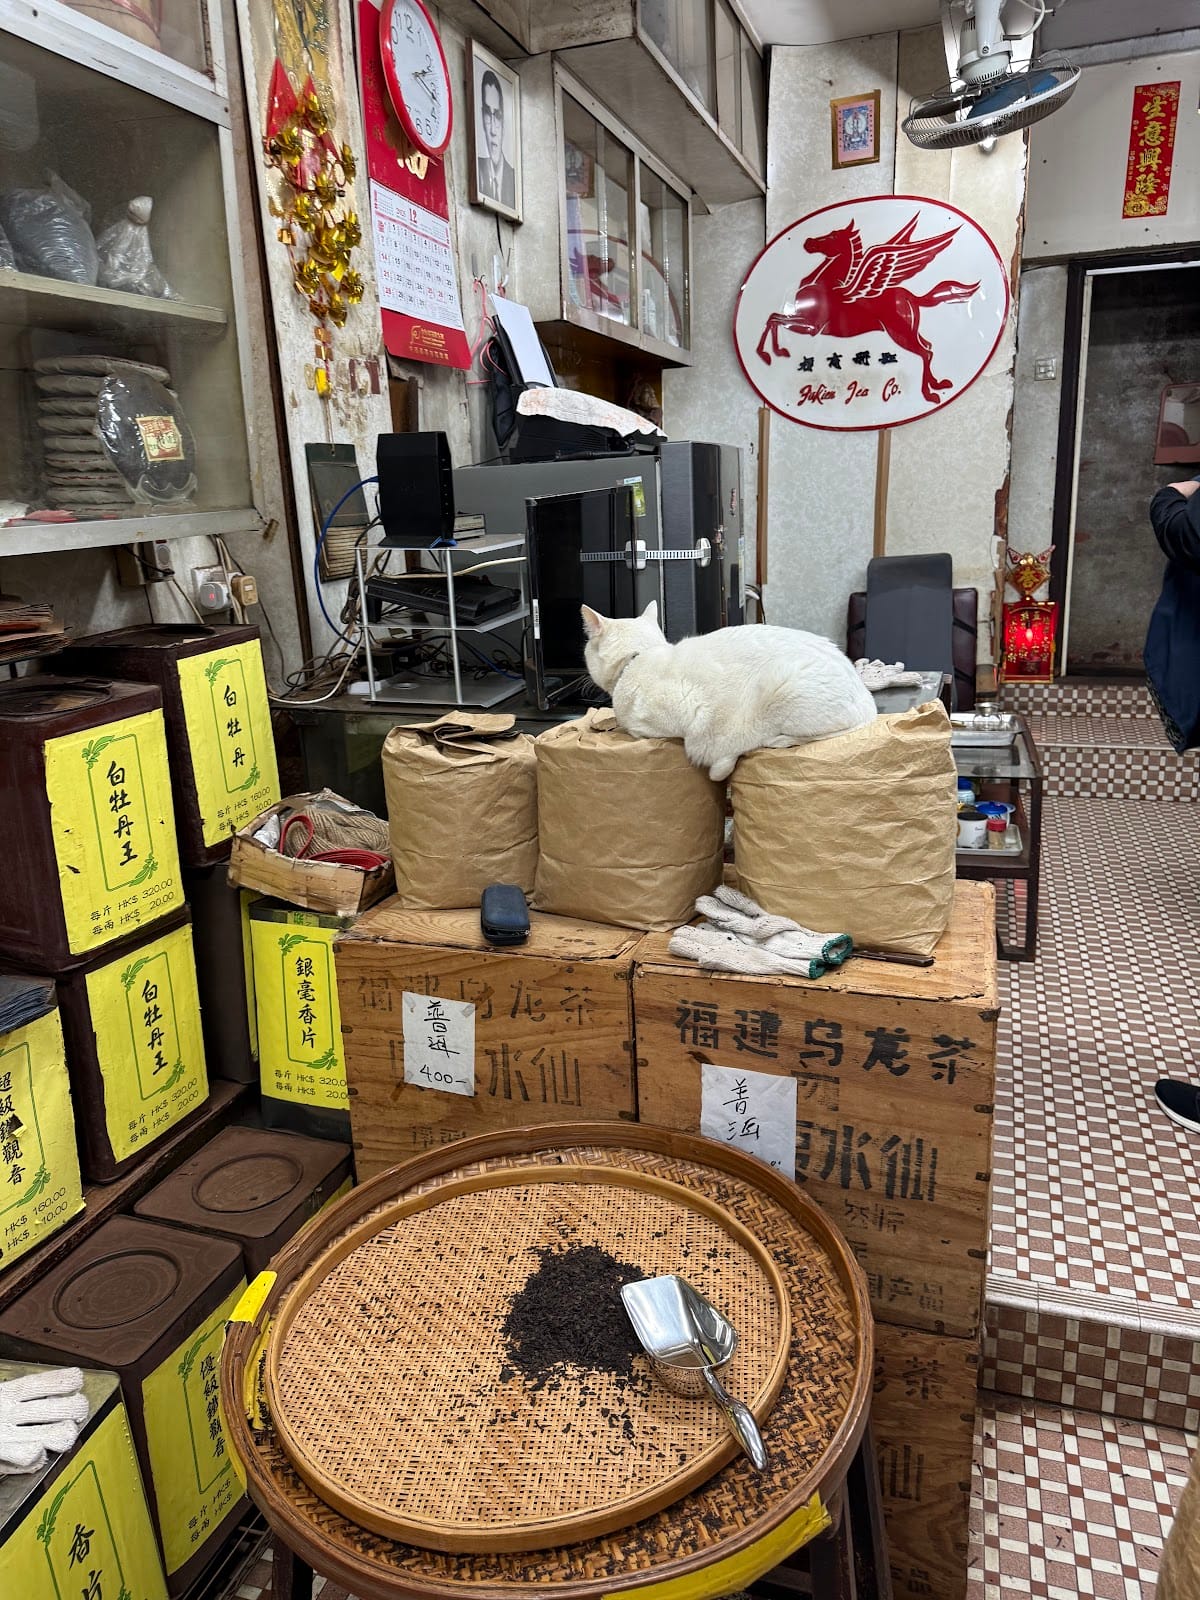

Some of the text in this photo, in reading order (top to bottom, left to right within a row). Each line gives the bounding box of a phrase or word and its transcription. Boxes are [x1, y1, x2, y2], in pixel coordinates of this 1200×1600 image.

[1135, 95, 1167, 195] 生意興隆
[409, 207, 417, 224] 12
[797, 384, 836, 406] Fukien
[882, 377, 902, 403] Co.
[223, 684, 246, 768] 白牡丹
[107, 761, 138, 866] 白牡丹王
[234, 800, 248, 811] HK$
[251, 786, 271, 801] 160.00
[236, 811, 250, 822] HK$
[256, 798, 272, 812] 10.00
[118, 895, 139, 911] HK$
[142, 878, 173, 899] 320.00
[120, 909, 141, 925] HK$
[149, 891, 175, 911] 20.00
[295, 956, 317, 1049] 銀毫香片
[141, 979, 169, 1076] 白牡丹王
[675, 999, 977, 1086] 福建乌龙茶
[151, 1099, 168, 1116] HK$
[171, 1078, 198, 1102] 320.00
[296, 1073, 315, 1085] HK$
[297, 1085, 316, 1097] HK$
[153, 1113, 170, 1129] HK$
[177, 1091, 199, 1111] 20.00
[5, 1187, 66, 1236] HK$ 160.00
[8, 1201, 68, 1250] HK$ 10.00
